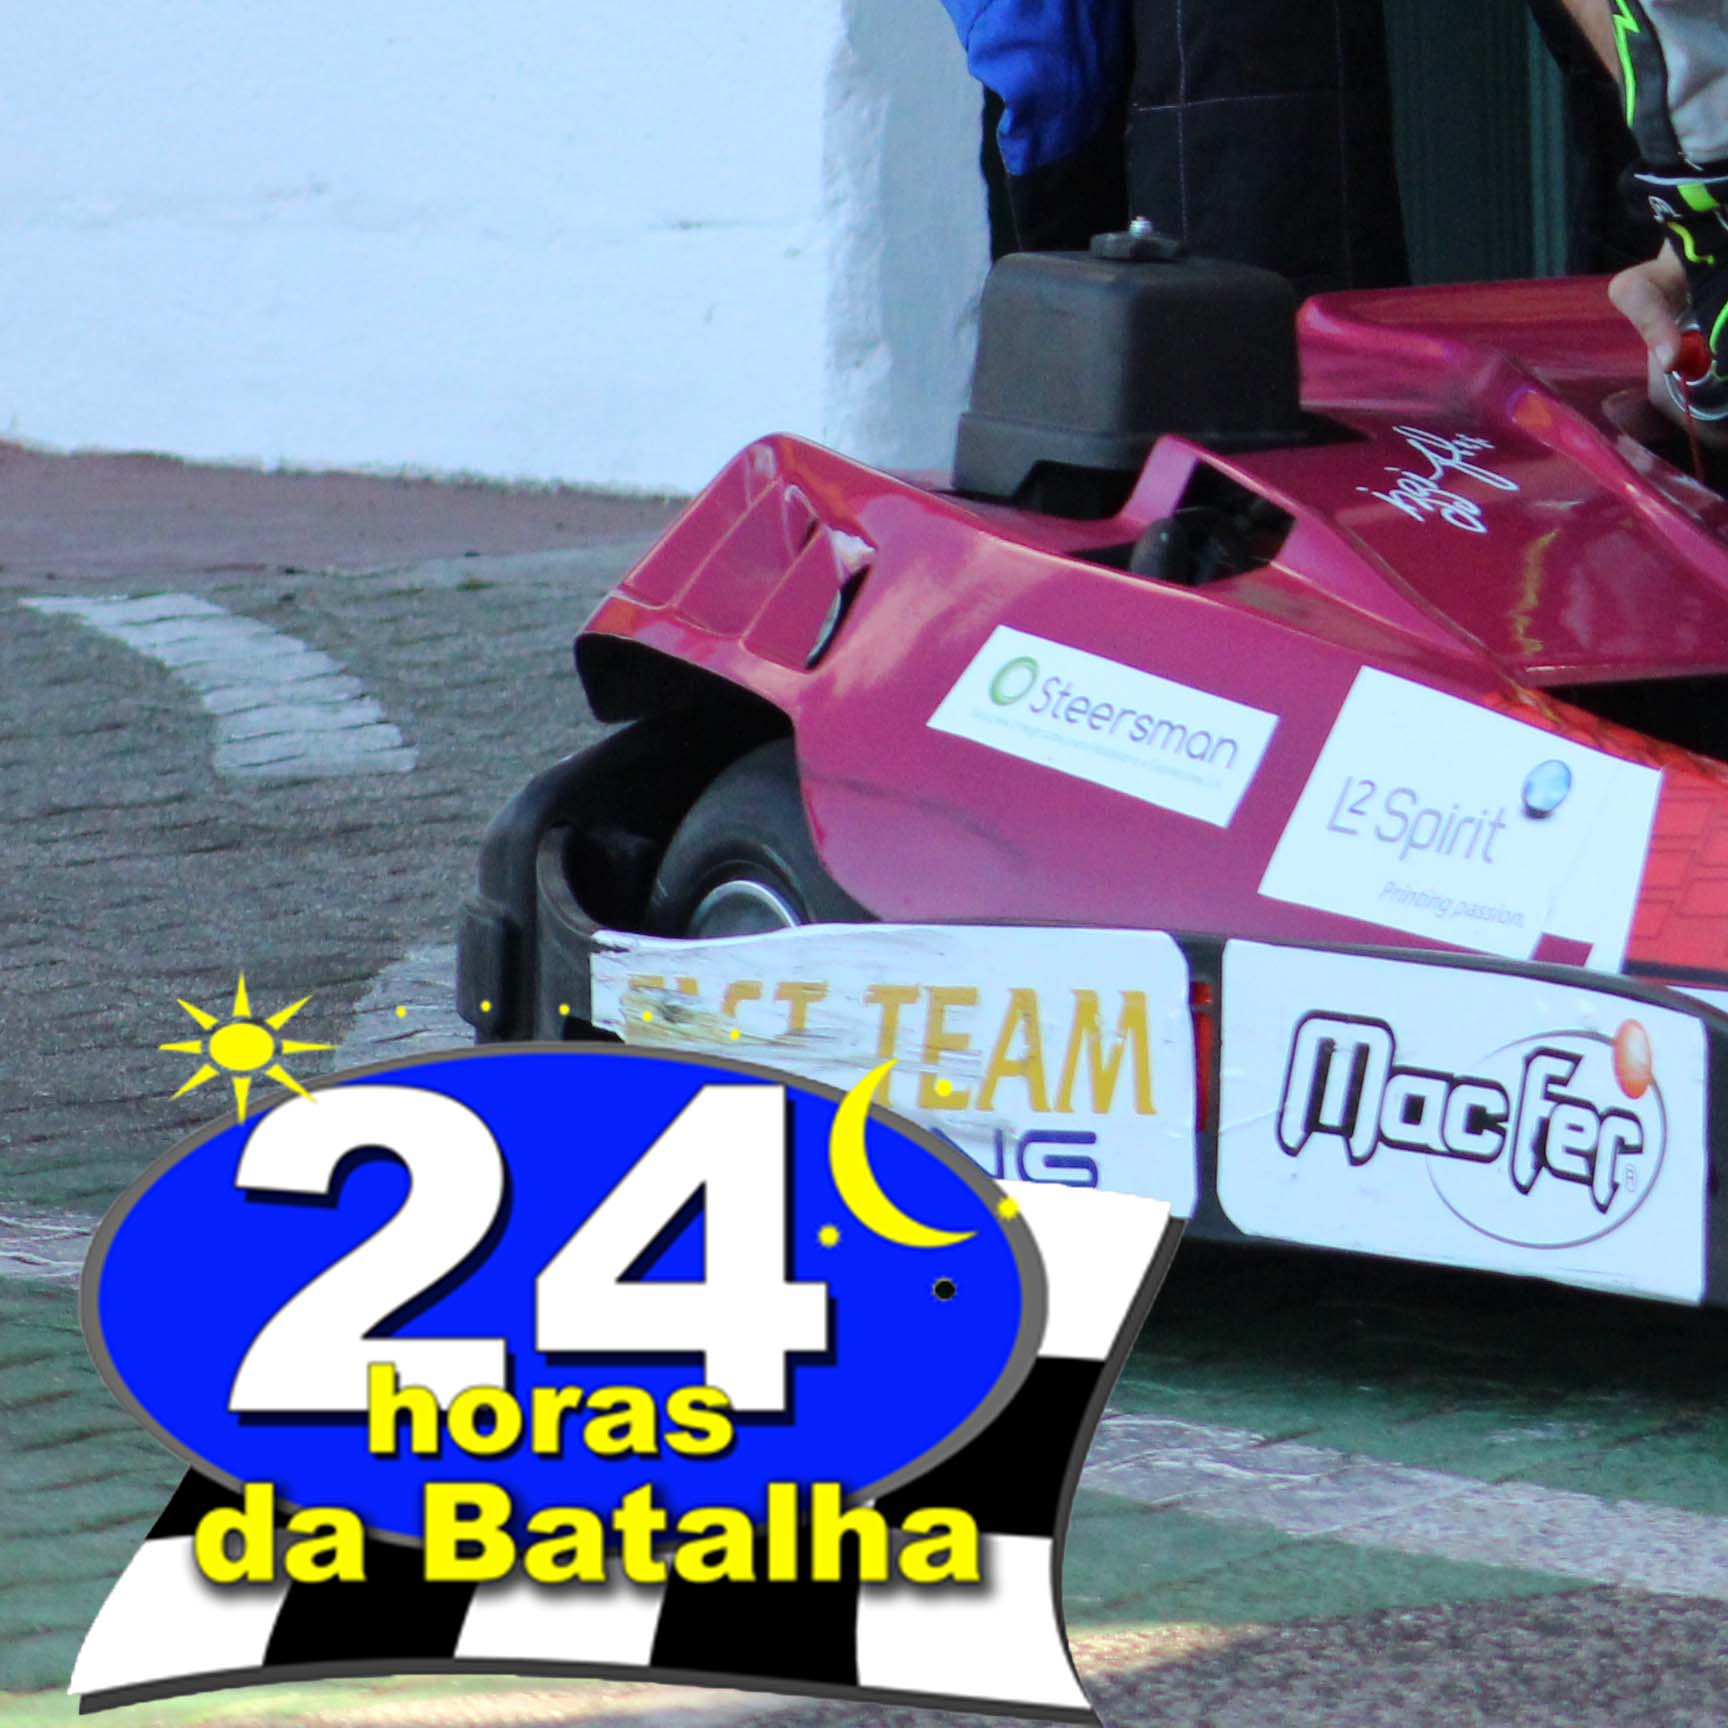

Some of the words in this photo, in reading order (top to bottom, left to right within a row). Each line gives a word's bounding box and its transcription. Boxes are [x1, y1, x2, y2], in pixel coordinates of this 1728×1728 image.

[1029, 675, 1239, 770] Steersman
[1375, 786, 1507, 864] Spirit
[864, 984, 1158, 1116] TEAM
